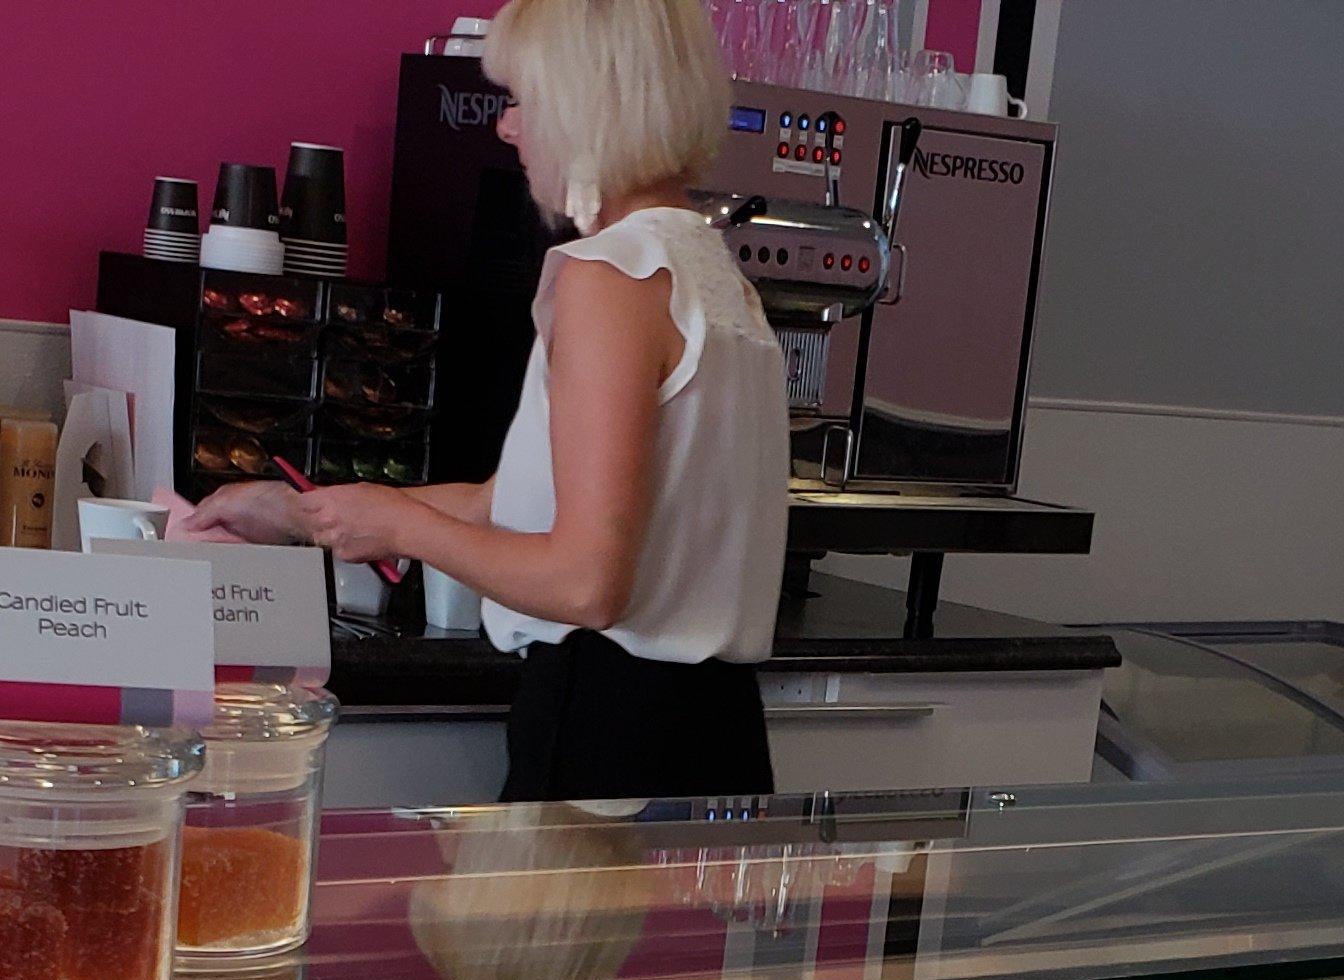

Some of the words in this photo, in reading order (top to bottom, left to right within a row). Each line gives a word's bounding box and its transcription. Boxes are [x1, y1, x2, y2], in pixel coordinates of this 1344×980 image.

[437, 83, 507, 131] NESP
[912, 145, 1026, 185] NESPRESSO
[231, 585, 276, 602] Fruit
[94, 598, 149, 619] Fruit
[213, 607, 259, 623] darin
[38, 618, 107, 639] Peach
